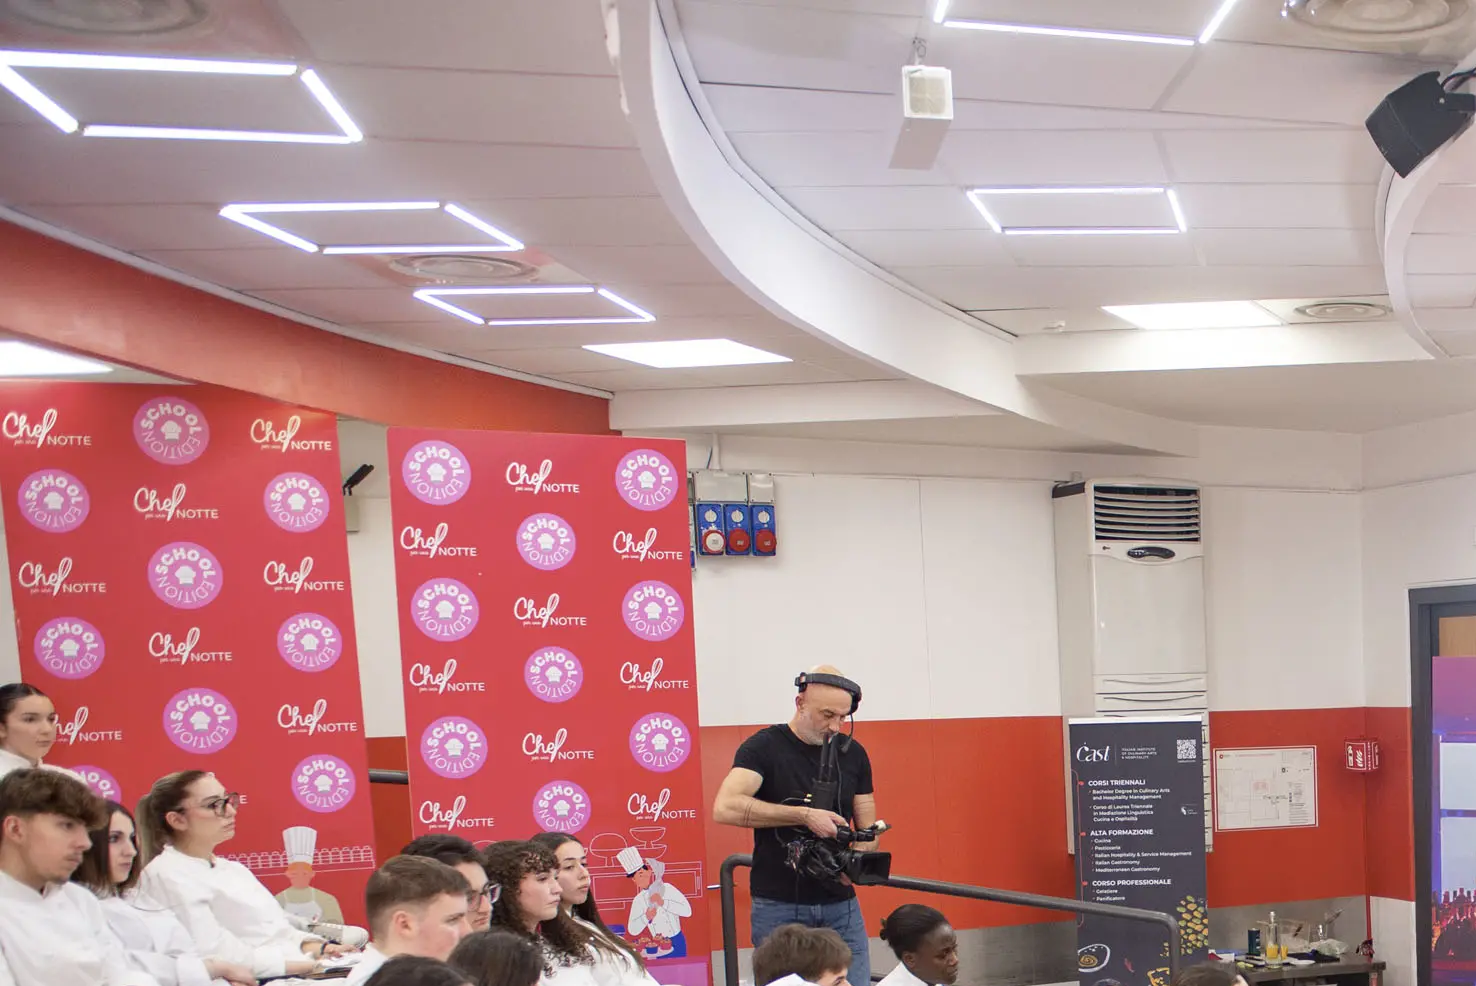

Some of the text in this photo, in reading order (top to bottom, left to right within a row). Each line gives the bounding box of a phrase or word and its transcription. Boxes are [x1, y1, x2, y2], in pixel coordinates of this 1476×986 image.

[2, 408, 57, 448] Chef
[47, 435, 92, 445] NOTTE
[140, 403, 202, 460] SCHOOL EDITION
[250, 415, 300, 452] Chef
[291, 440, 332, 450] NOTTE
[409, 446, 464, 501] SCHOOL EDITION
[505, 459, 552, 494] Chef
[543, 484, 580, 493] NOTTE
[621, 454, 672, 507] SCHOOL EDITION
[25, 475, 83, 529] SCHOOL EDITION
[134, 483, 186, 521] Chef
[176, 508, 219, 519] NOTTE
[269, 477, 322, 529] SCHOOL EDITION
[401, 523, 448, 558] Chef
[438, 547, 477, 557] NOTTE
[522, 518, 570, 567] SCHOOL EDITION
[613, 527, 657, 562] Chef
[648, 551, 683, 560] NOTTE
[18, 557, 72, 596] Chef
[62, 582, 106, 593] NOTTE
[155, 548, 215, 605] SCHOOL EDITION
[263, 556, 313, 593] Chef
[304, 581, 344, 591] NOTTE
[417, 584, 472, 637] SCHOOL EDITION
[513, 593, 559, 628] Chef
[550, 617, 587, 626] NOTTE
[628, 586, 678, 638] SCHOOL EDITION
[40, 622, 98, 675] SCHOOL EDITION
[148, 627, 200, 665] Chef
[190, 652, 232, 662] NOTTE
[283, 618, 336, 668] SCHOOL EDITION
[409, 658, 457, 695] Chef
[448, 682, 485, 692] NOTTE
[530, 652, 577, 699] SCHOOL EDITION
[620, 658, 663, 692] Chef
[654, 680, 689, 689] NOTTE
[53, 706, 88, 745] hef
[170, 694, 230, 750] SCHOOL EDITION
[277, 699, 326, 736] Chef
[317, 723, 357, 732] NOTTE
[79, 731, 122, 741] NOTTE
[426, 722, 481, 775] SCHOOL EDITION
[522, 728, 567, 762] Chef
[635, 718, 685, 769] SCHOOL EDITION
[1077, 742, 1109, 761] Cast
[558, 750, 595, 759] NOTTE
[297, 759, 349, 788] SCHOOL
[297, 786, 349, 809] EDITION
[419, 795, 466, 831] Chef
[538, 785, 585, 832] SCHOOL EDITION
[627, 788, 670, 822] Chef
[661, 810, 696, 819] NOTTE
[456, 818, 494, 828] NOTTE
